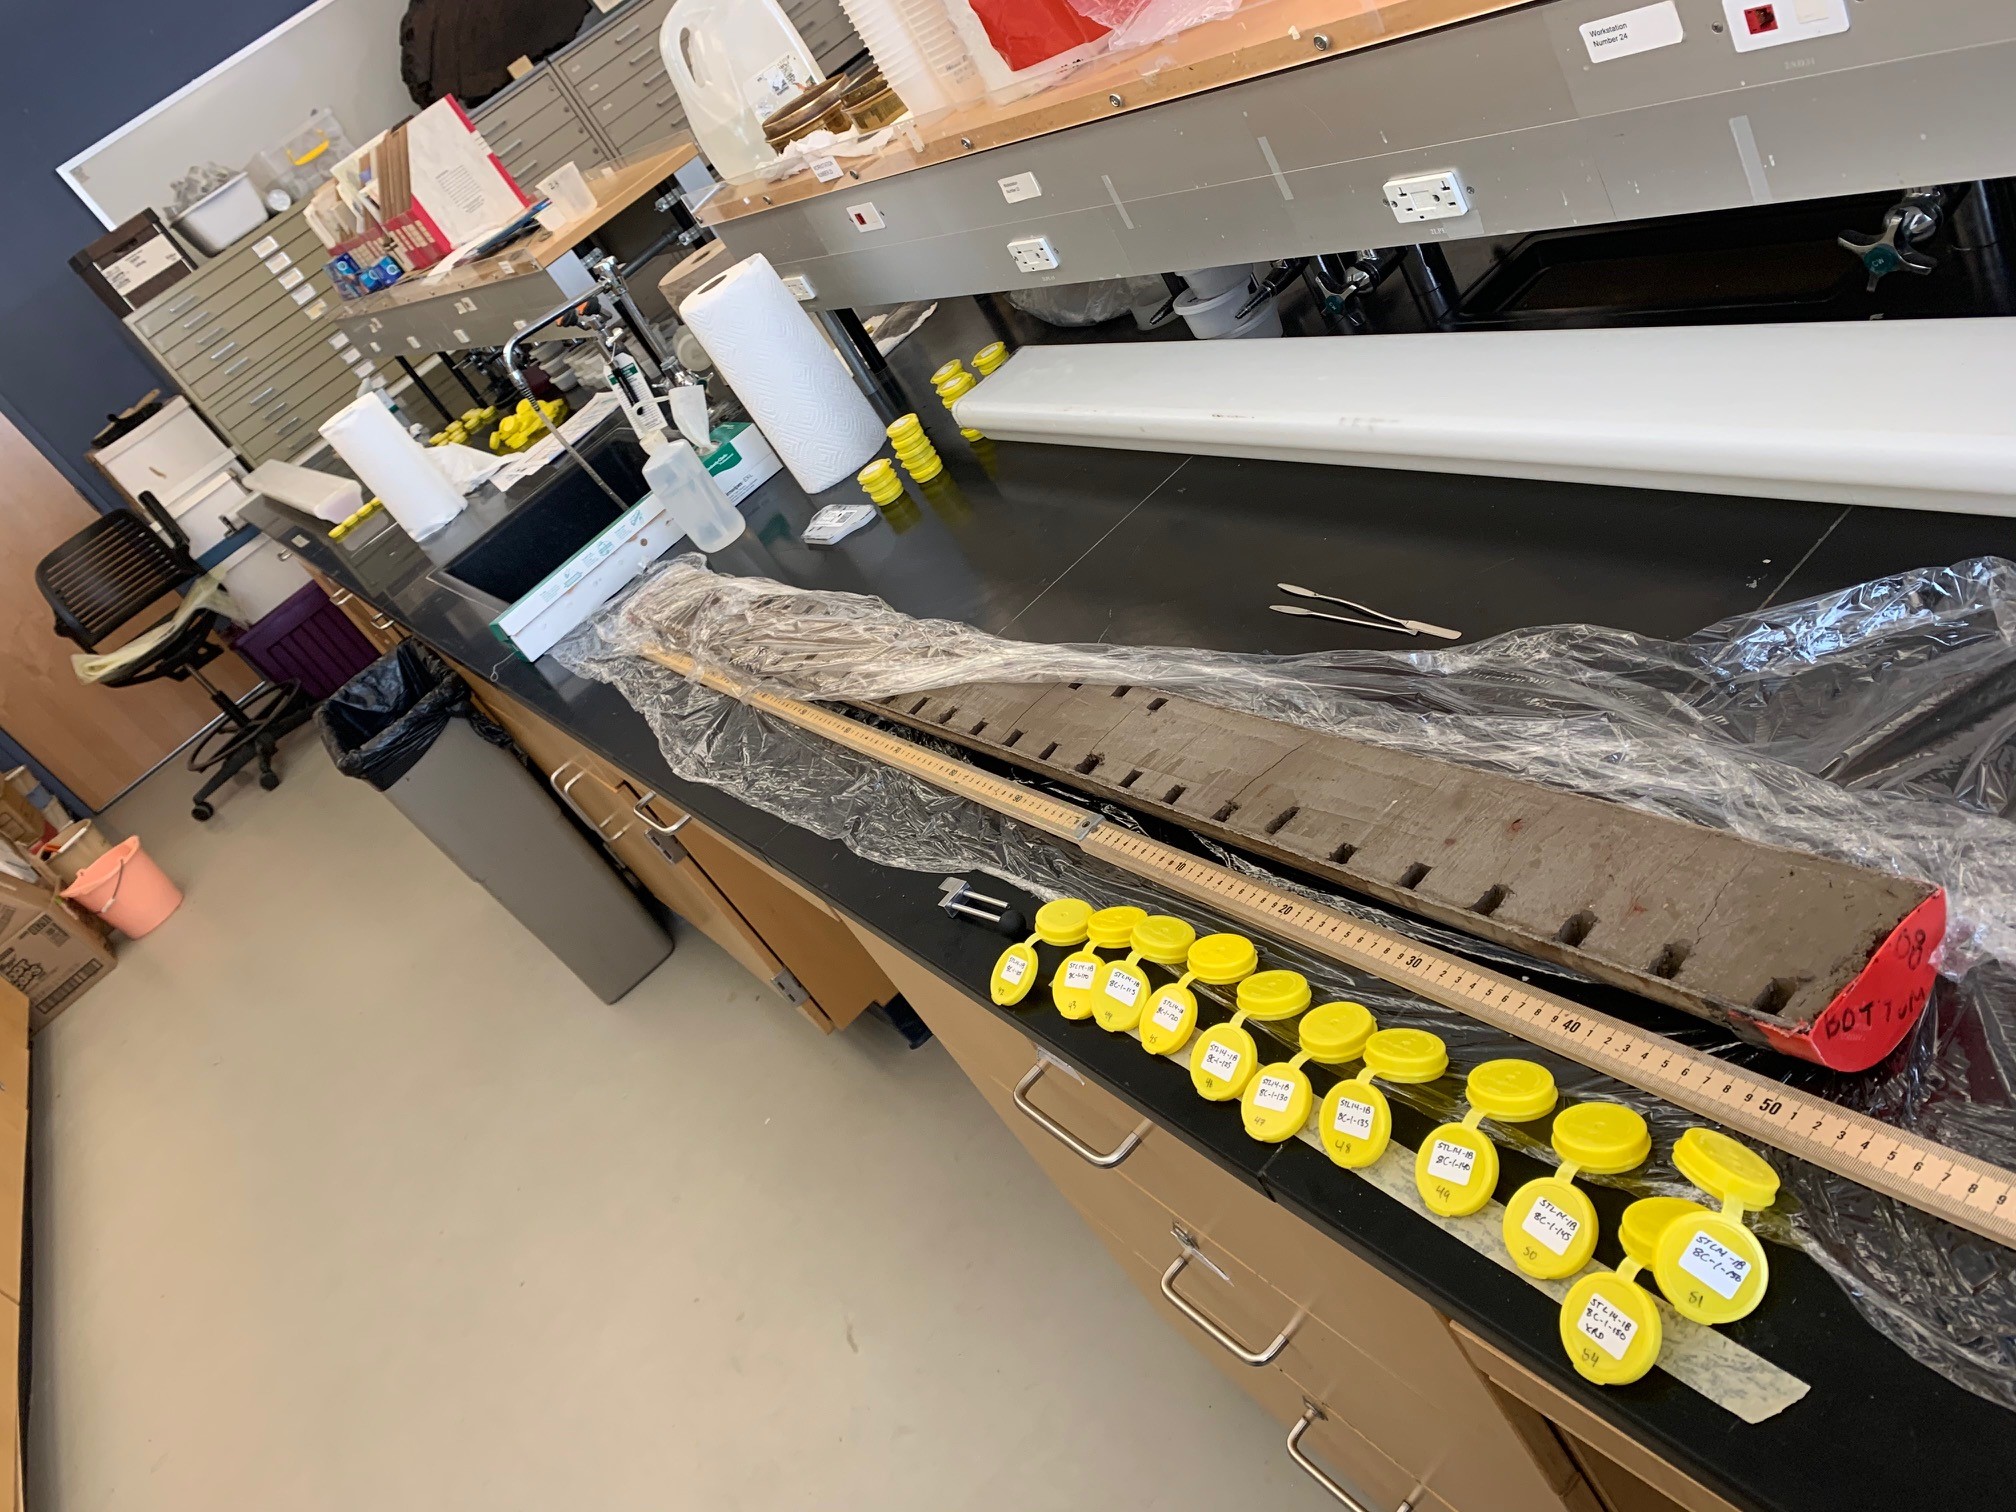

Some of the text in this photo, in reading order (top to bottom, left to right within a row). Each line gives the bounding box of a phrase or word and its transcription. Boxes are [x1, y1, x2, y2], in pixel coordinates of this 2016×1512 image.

[1589, 23, 1627, 37] Workstation
[1593, 33, 1628, 47] Number 24
[1175, 862, 1186, 871] 10
[1278, 905, 1293, 915] 20
[1406, 956, 1422, 968] 30
[1501, 995, 1510, 1003] 6
[1534, 1008, 1542, 1016] 8
[1551, 1015, 1559, 1023] 9
[1562, 1019, 1582, 1033] 40
[1586, 1029, 1593, 1037] 1
[1604, 1037, 1612, 1045] 2
[1622, 1044, 1631, 1053] 3
[1641, 1052, 1649, 1060] 4
[1661, 1060, 1670, 1068] 5
[1681, 1068, 1690, 1076] 6
[1702, 1076, 1711, 1085] 7
[1722, 1084, 1731, 1093] 8
[1744, 1093, 1754, 1102] 9
[1759, 1099, 1782, 1115] 50
[1790, 1111, 1798, 1120] 1
[1812, 1121, 1823, 1131] 2
[1836, 1131, 1846, 1140] 3
[1860, 1141, 1871, 1150] 4
[1887, 1151, 1898, 1161] 5
[1913, 1161, 1924, 1172] 6
[1940, 1172, 1951, 1182] 7
[1968, 1183, 1979, 1193] 8
[1996, 1195, 2008, 1205] 9
[1254, 1116, 1265, 1126] 47
[1335, 1140, 1351, 1153] 48
[1436, 1186, 1450, 1202] 49
[1523, 1247, 1537, 1260] 50
[1689, 1291, 1703, 1307] 51
[1582, 1348, 1599, 1367] 54
